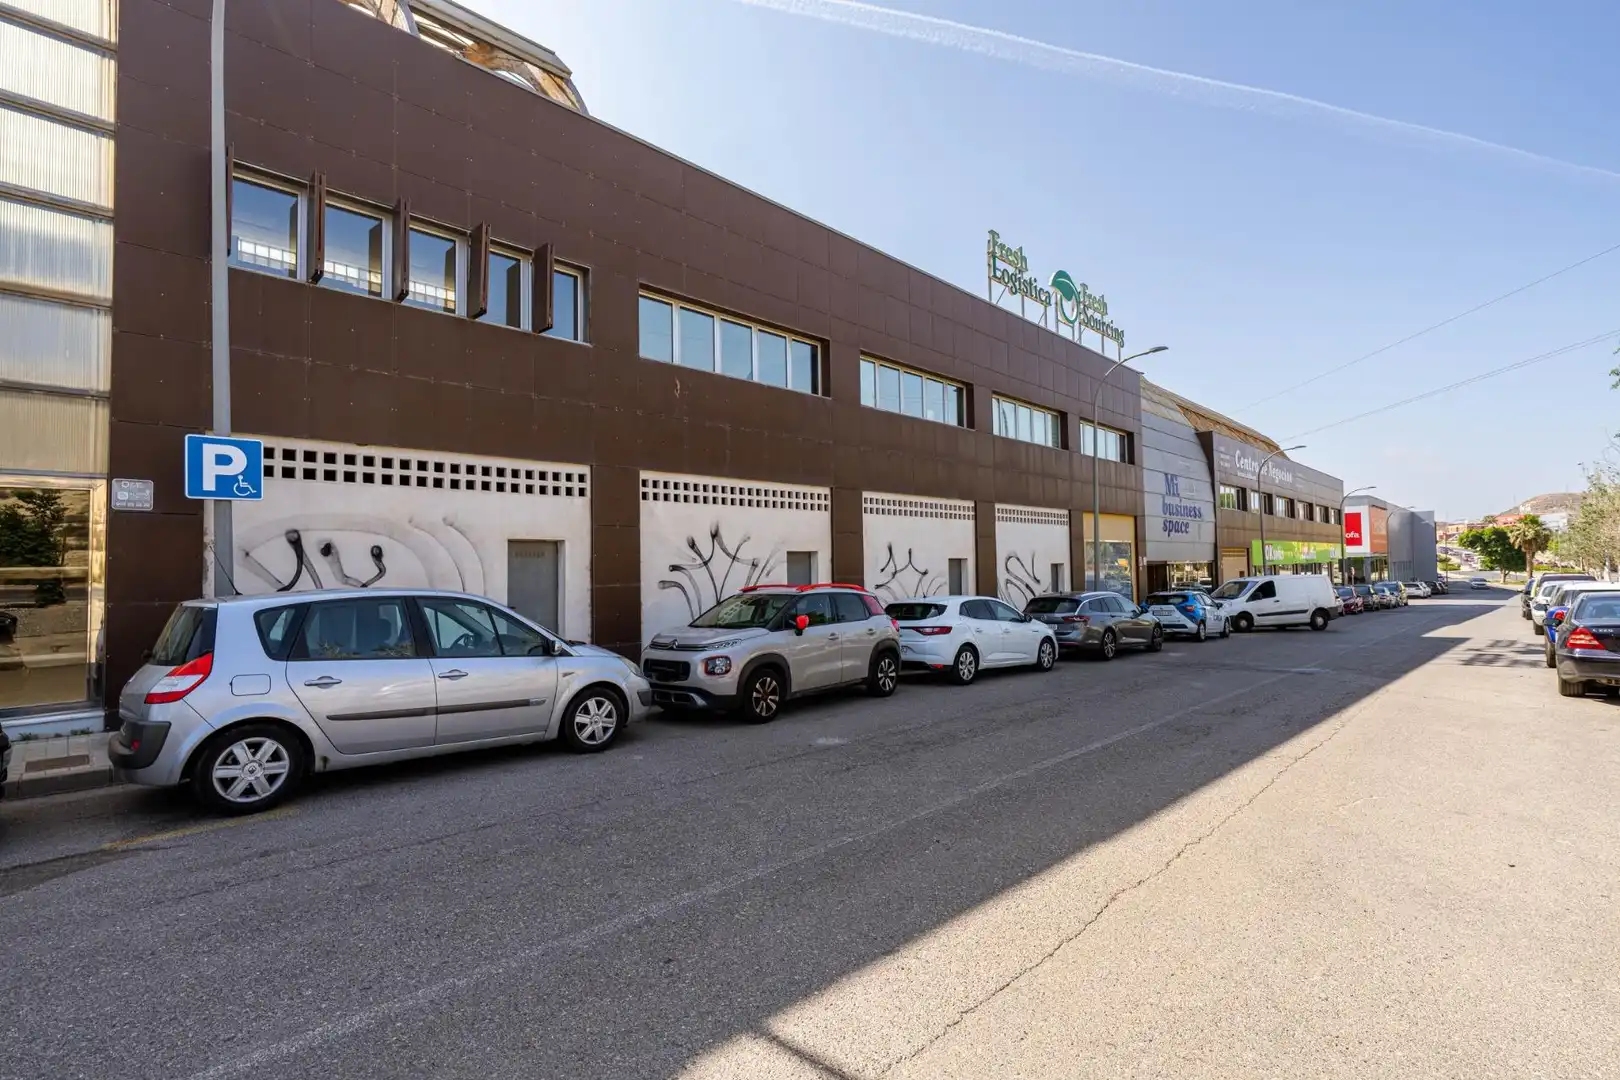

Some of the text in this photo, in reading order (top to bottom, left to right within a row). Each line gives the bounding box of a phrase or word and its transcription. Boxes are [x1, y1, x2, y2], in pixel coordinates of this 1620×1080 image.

[988, 229, 1028, 272] Fresh
[1080, 282, 1108, 316] Fresh
[1083, 305, 1125, 348] Sourcing
[202, 443, 247, 491] P
[1235, 450, 1259, 473] Centro
[1164, 473, 1180, 497] Mi
[1162, 495, 1202, 519] business
[1162, 518, 1190, 537] space
